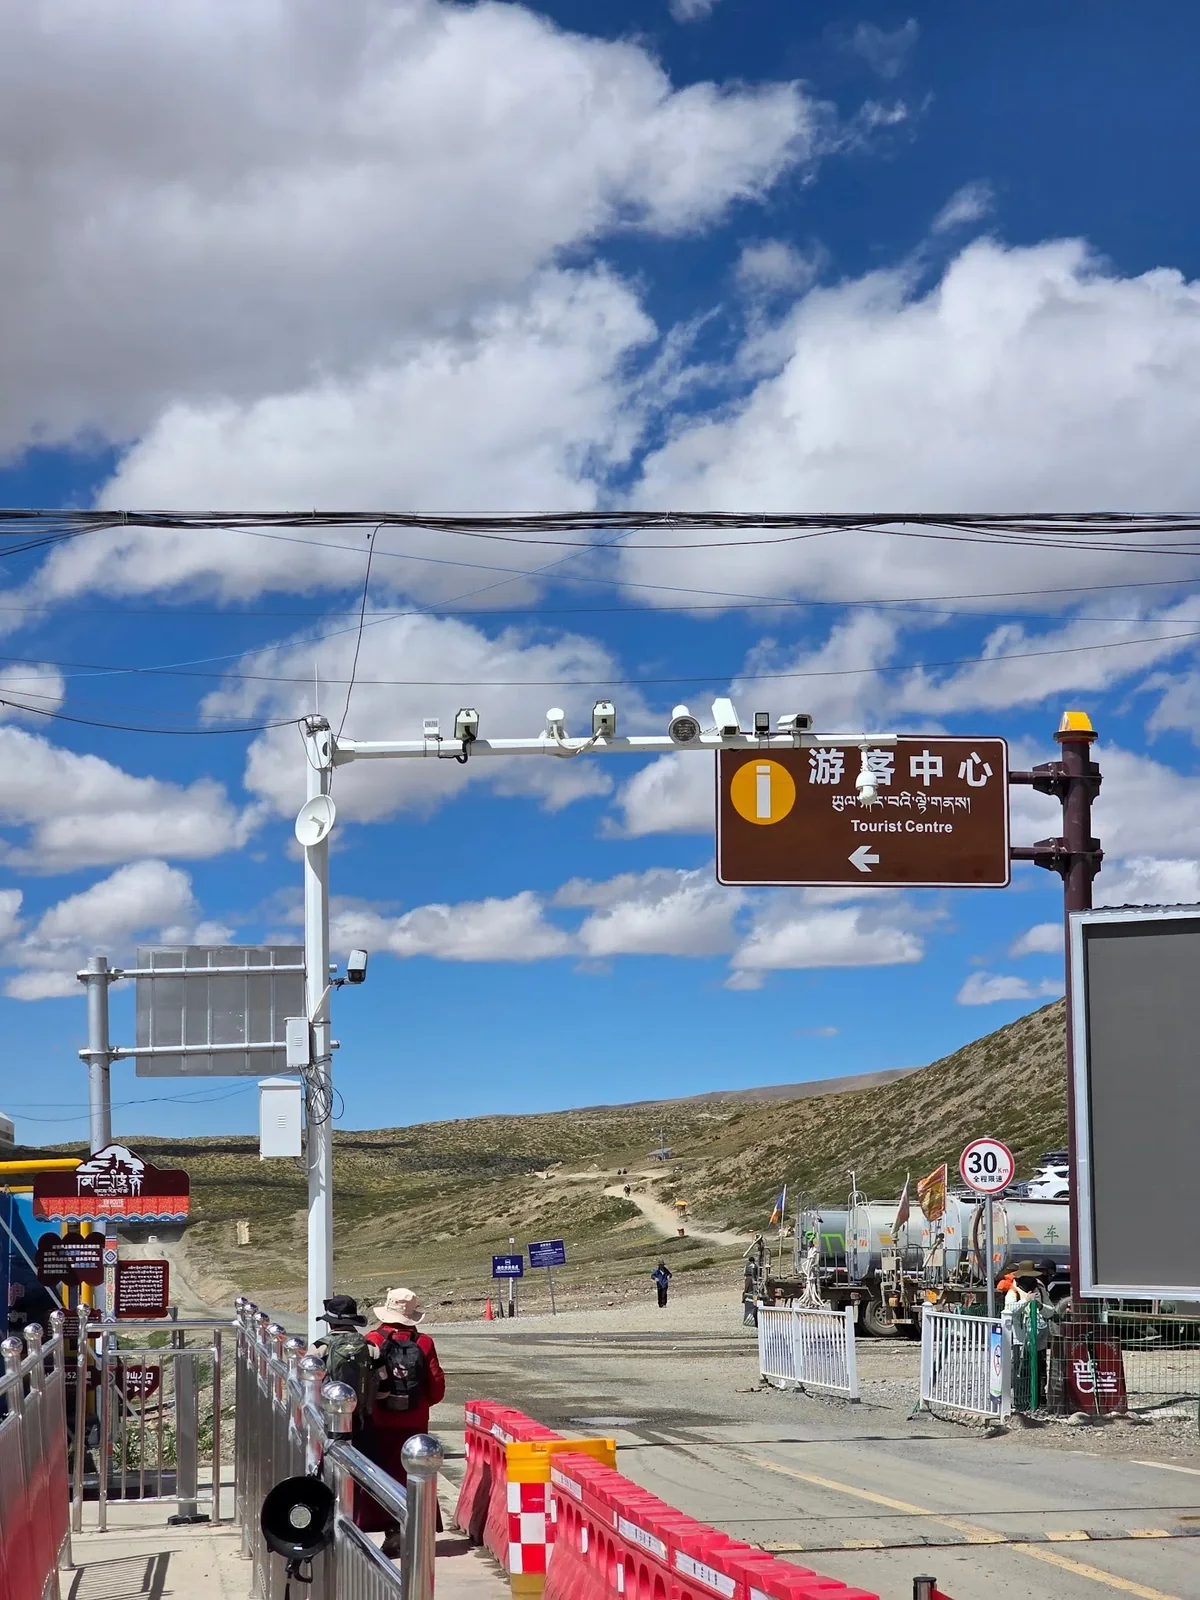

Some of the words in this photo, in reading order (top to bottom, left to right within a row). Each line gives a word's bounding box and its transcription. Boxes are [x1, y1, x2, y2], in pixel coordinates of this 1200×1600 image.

[808, 747, 994, 787] 游客中心
[851, 820, 902, 832] Tourist
[905, 820, 953, 833] Centre
[968, 1151, 997, 1174] 30
